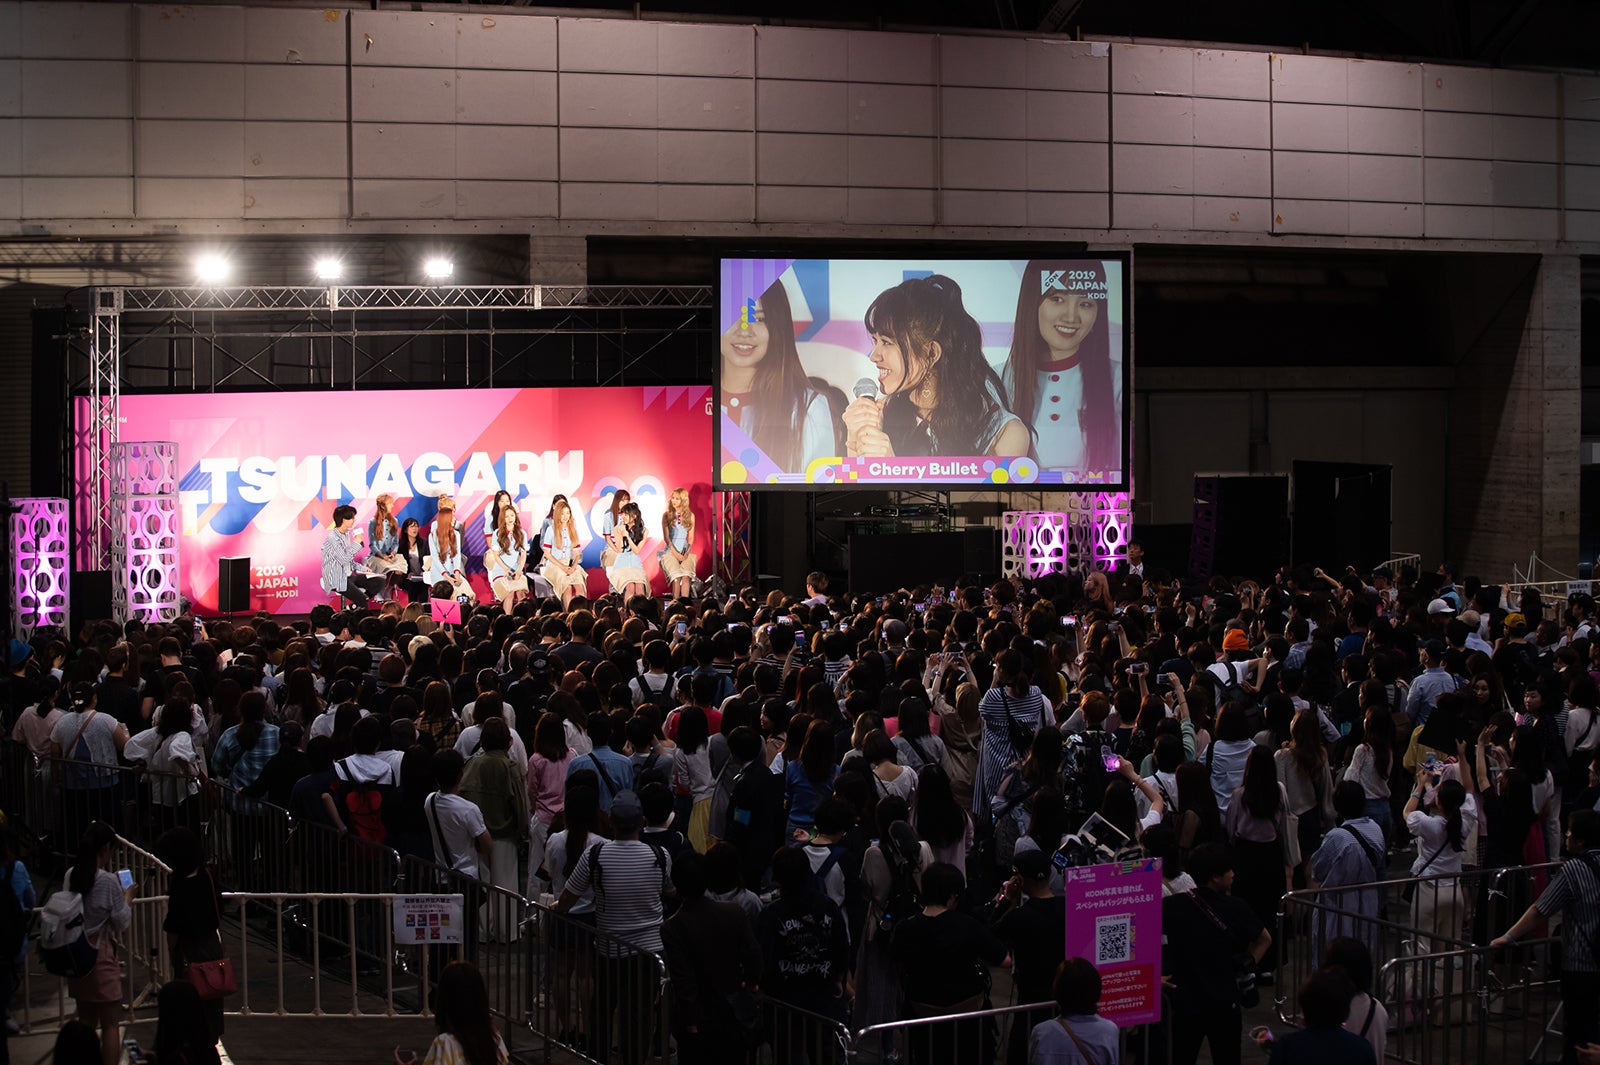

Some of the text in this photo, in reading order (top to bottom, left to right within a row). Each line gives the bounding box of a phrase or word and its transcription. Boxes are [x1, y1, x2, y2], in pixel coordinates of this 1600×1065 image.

[1068, 270, 1096, 280] 2019
[1068, 281, 1108, 290] JAPAN
[200, 450, 584, 503] TSUNAGARU
[869, 462, 978, 479] Cherry Bullet
[255, 565, 286, 577] 2019
[255, 577, 299, 589] JAPAN
[275, 590, 299, 599] KDDI
